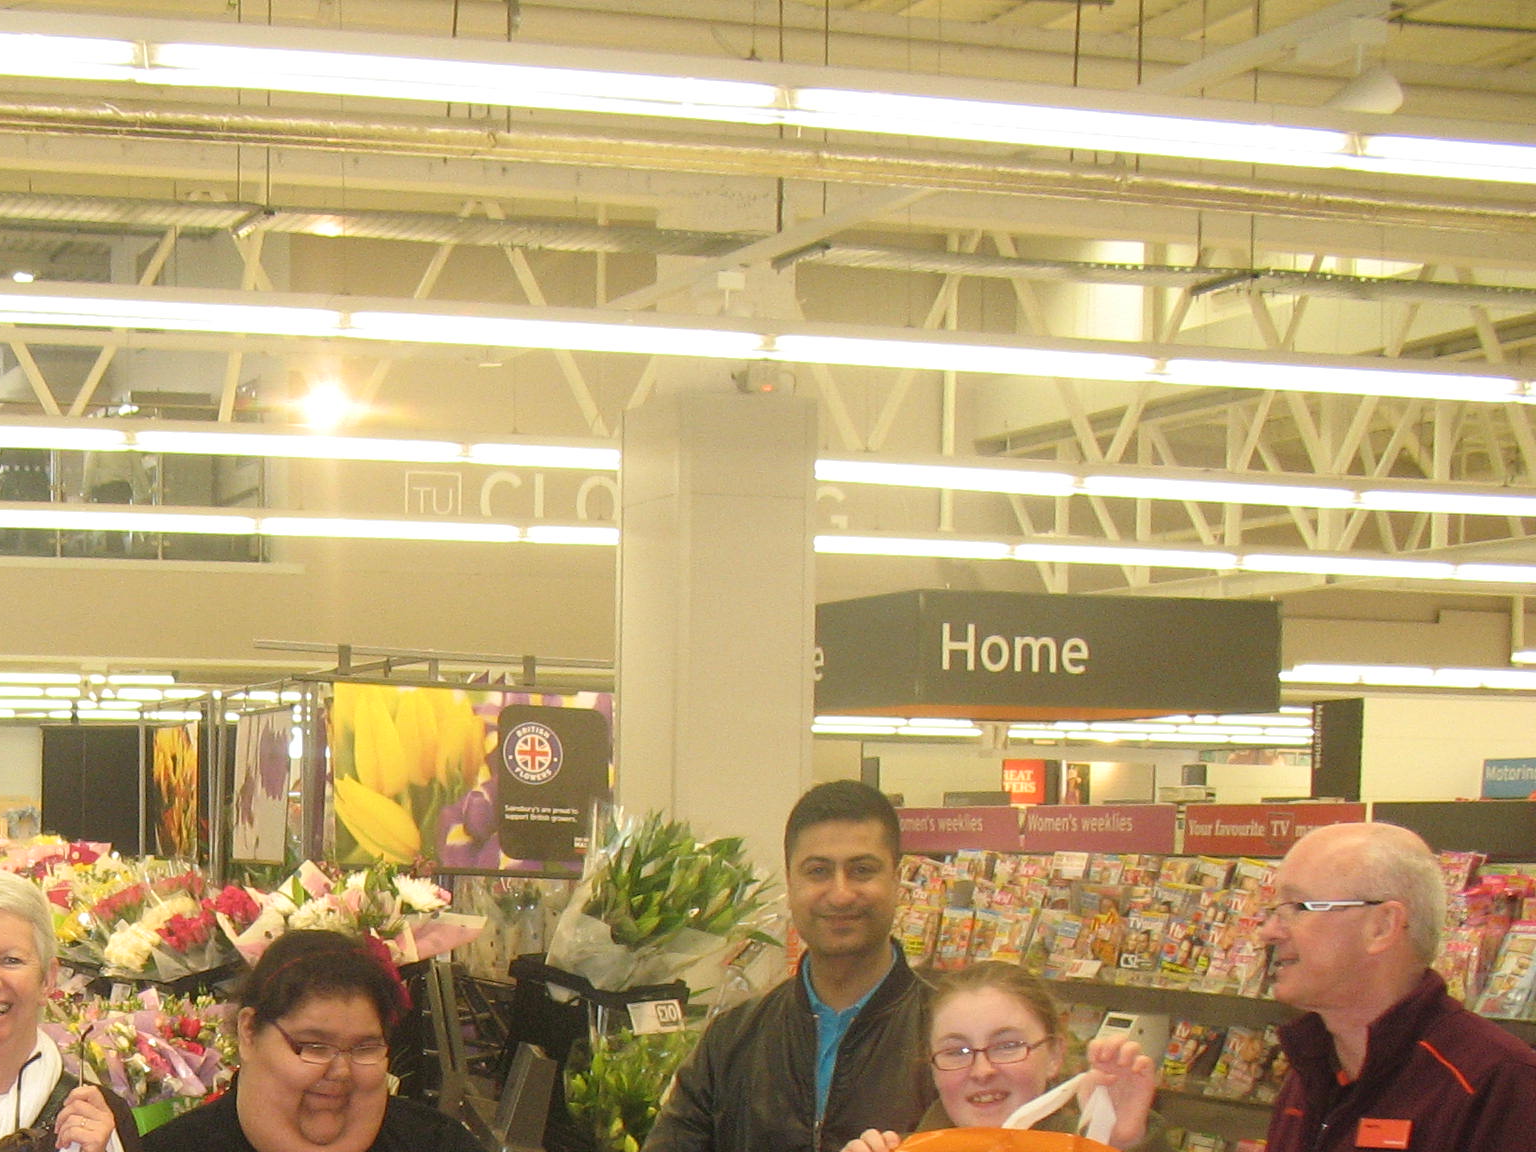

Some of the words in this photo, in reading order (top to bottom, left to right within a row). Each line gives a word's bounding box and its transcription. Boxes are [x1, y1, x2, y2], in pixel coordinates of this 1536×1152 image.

[941, 622, 1090, 675] Home
[515, 725, 551, 739] BRITISH
[514, 768, 552, 781] FLOWERS
[1486, 764, 1536, 782] Motorin
[899, 816, 935, 832] omen's
[938, 815, 983, 832] weeklies
[1028, 815, 1078, 832] Women's
[1081, 813, 1133, 832] weeklies
[1188, 819, 1212, 836] Your
[1214, 819, 1264, 836] favourite
[1270, 820, 1291, 837] TV
